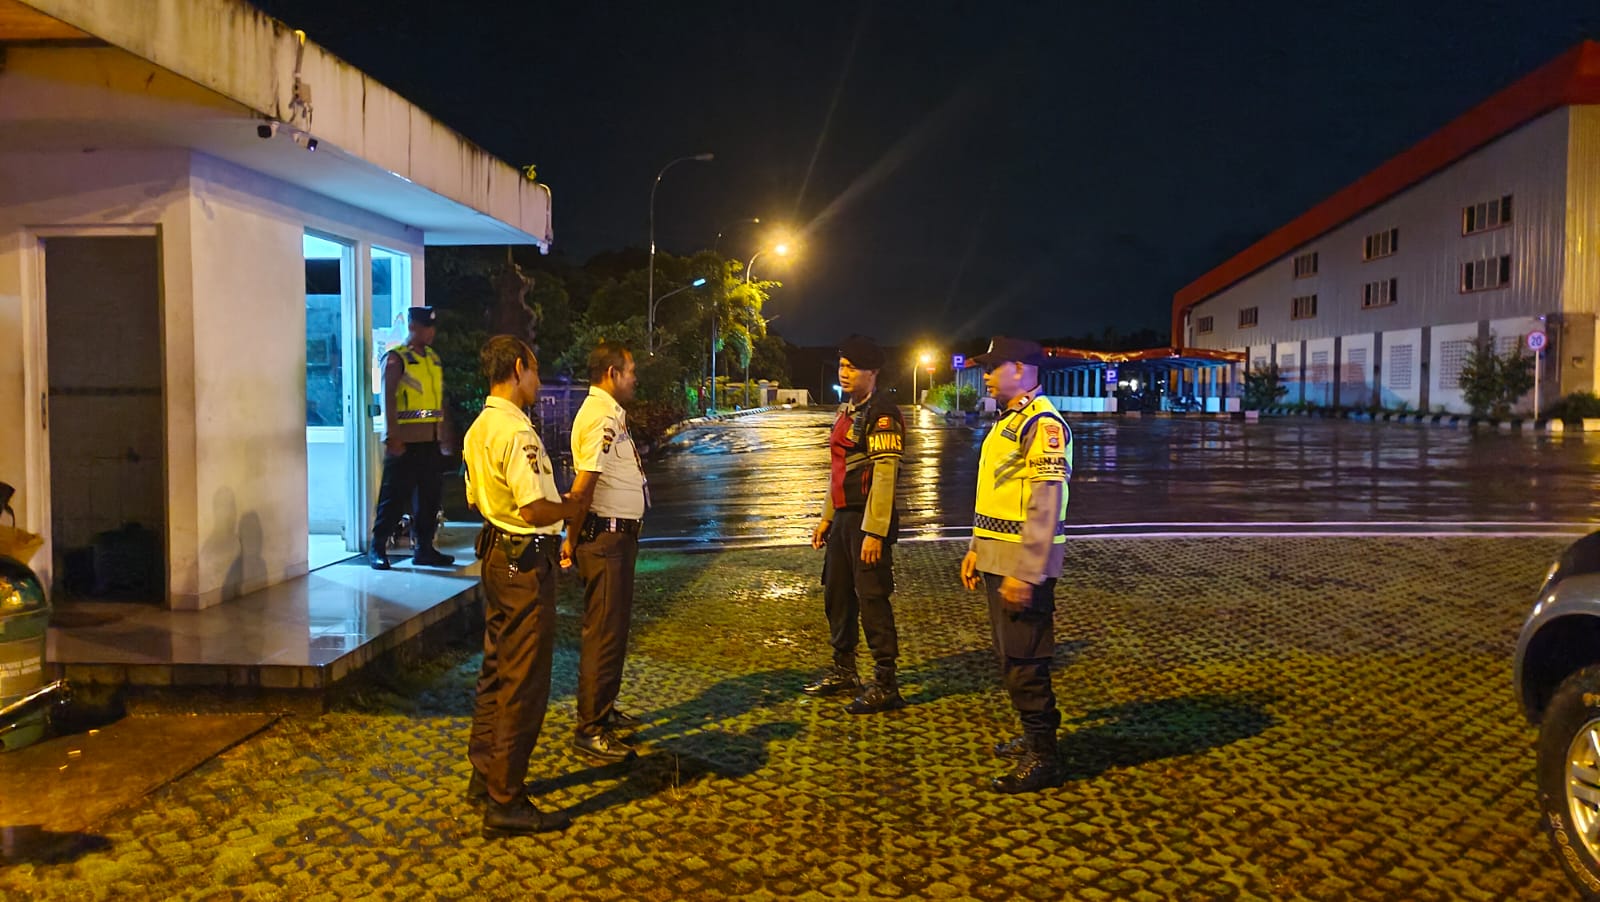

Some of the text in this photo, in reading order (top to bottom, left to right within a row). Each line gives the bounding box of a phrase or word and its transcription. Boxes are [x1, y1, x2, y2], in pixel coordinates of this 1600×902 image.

[1531, 335, 1542, 347] 20
[953, 355, 964, 368] P
[1106, 370, 1117, 382] P
[868, 433, 902, 453] PAWAS
